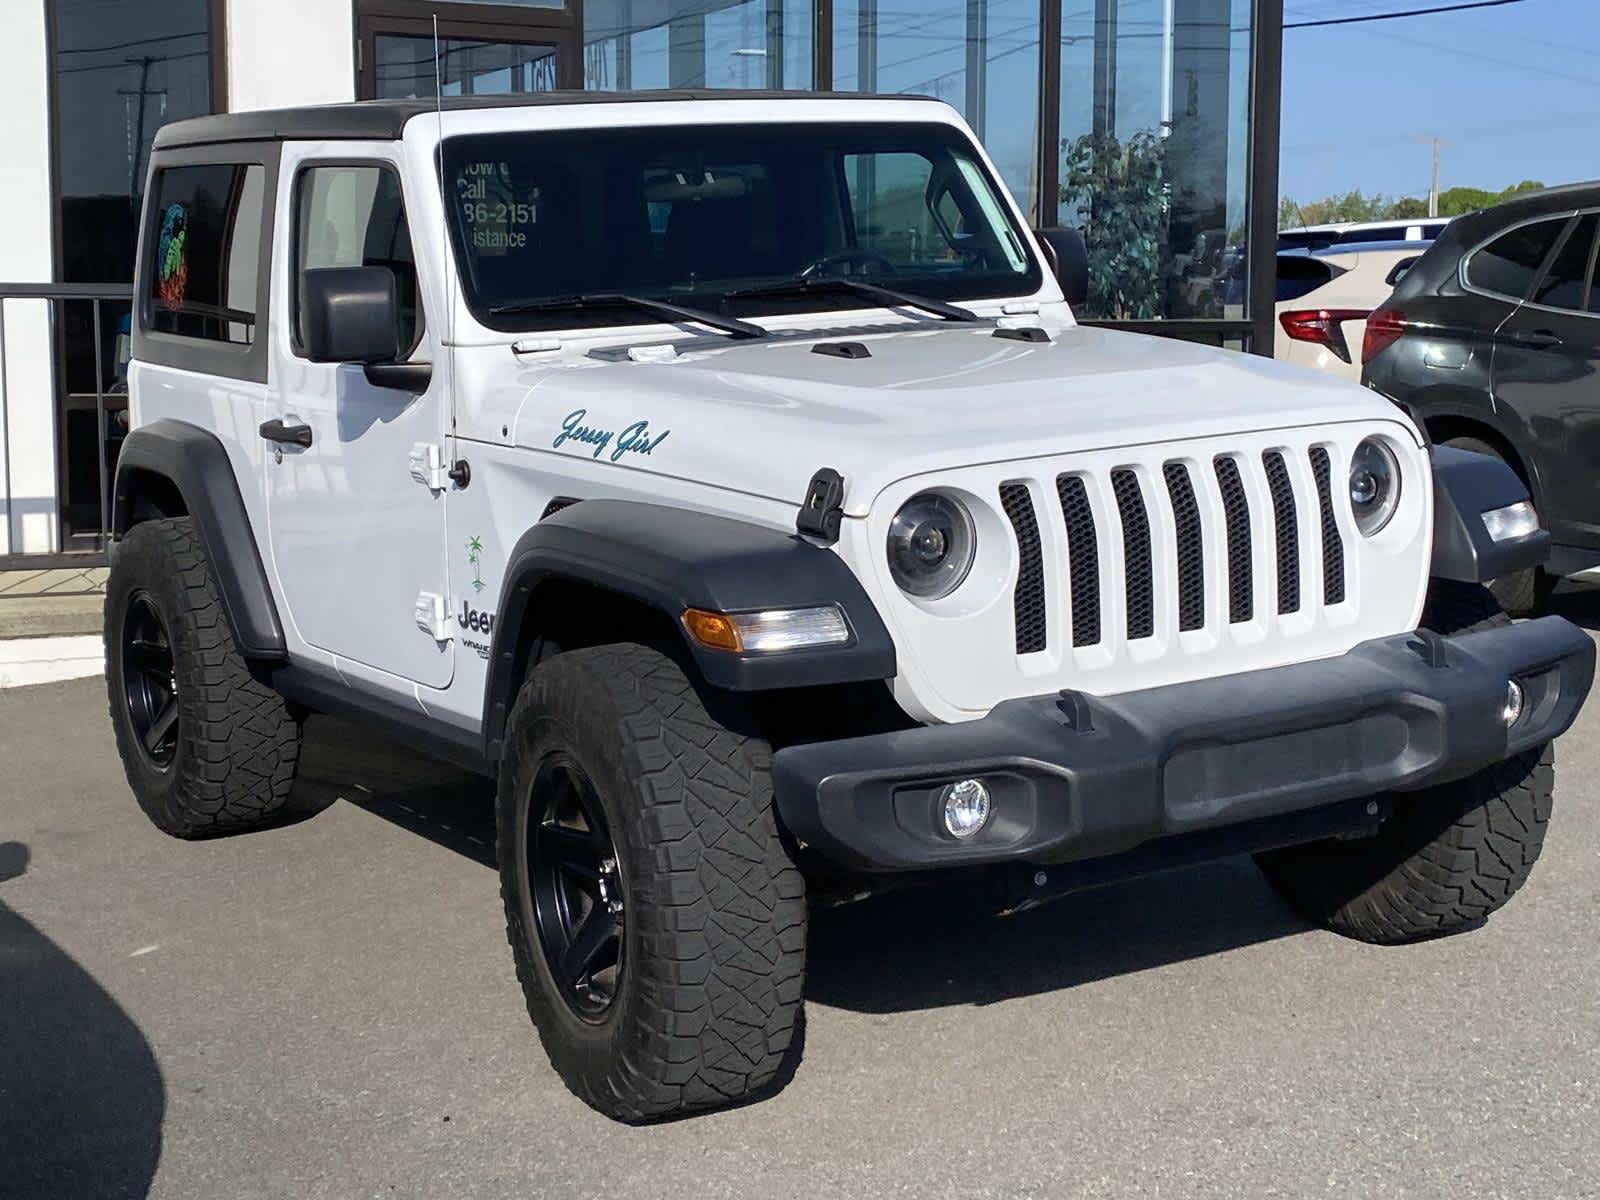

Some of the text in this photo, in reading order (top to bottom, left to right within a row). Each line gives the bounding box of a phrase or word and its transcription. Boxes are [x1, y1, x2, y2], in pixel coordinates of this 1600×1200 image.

[463, 203, 537, 224] 86-2151
[473, 227, 526, 248] istance
[552, 409, 671, 462] Jersey Girl
